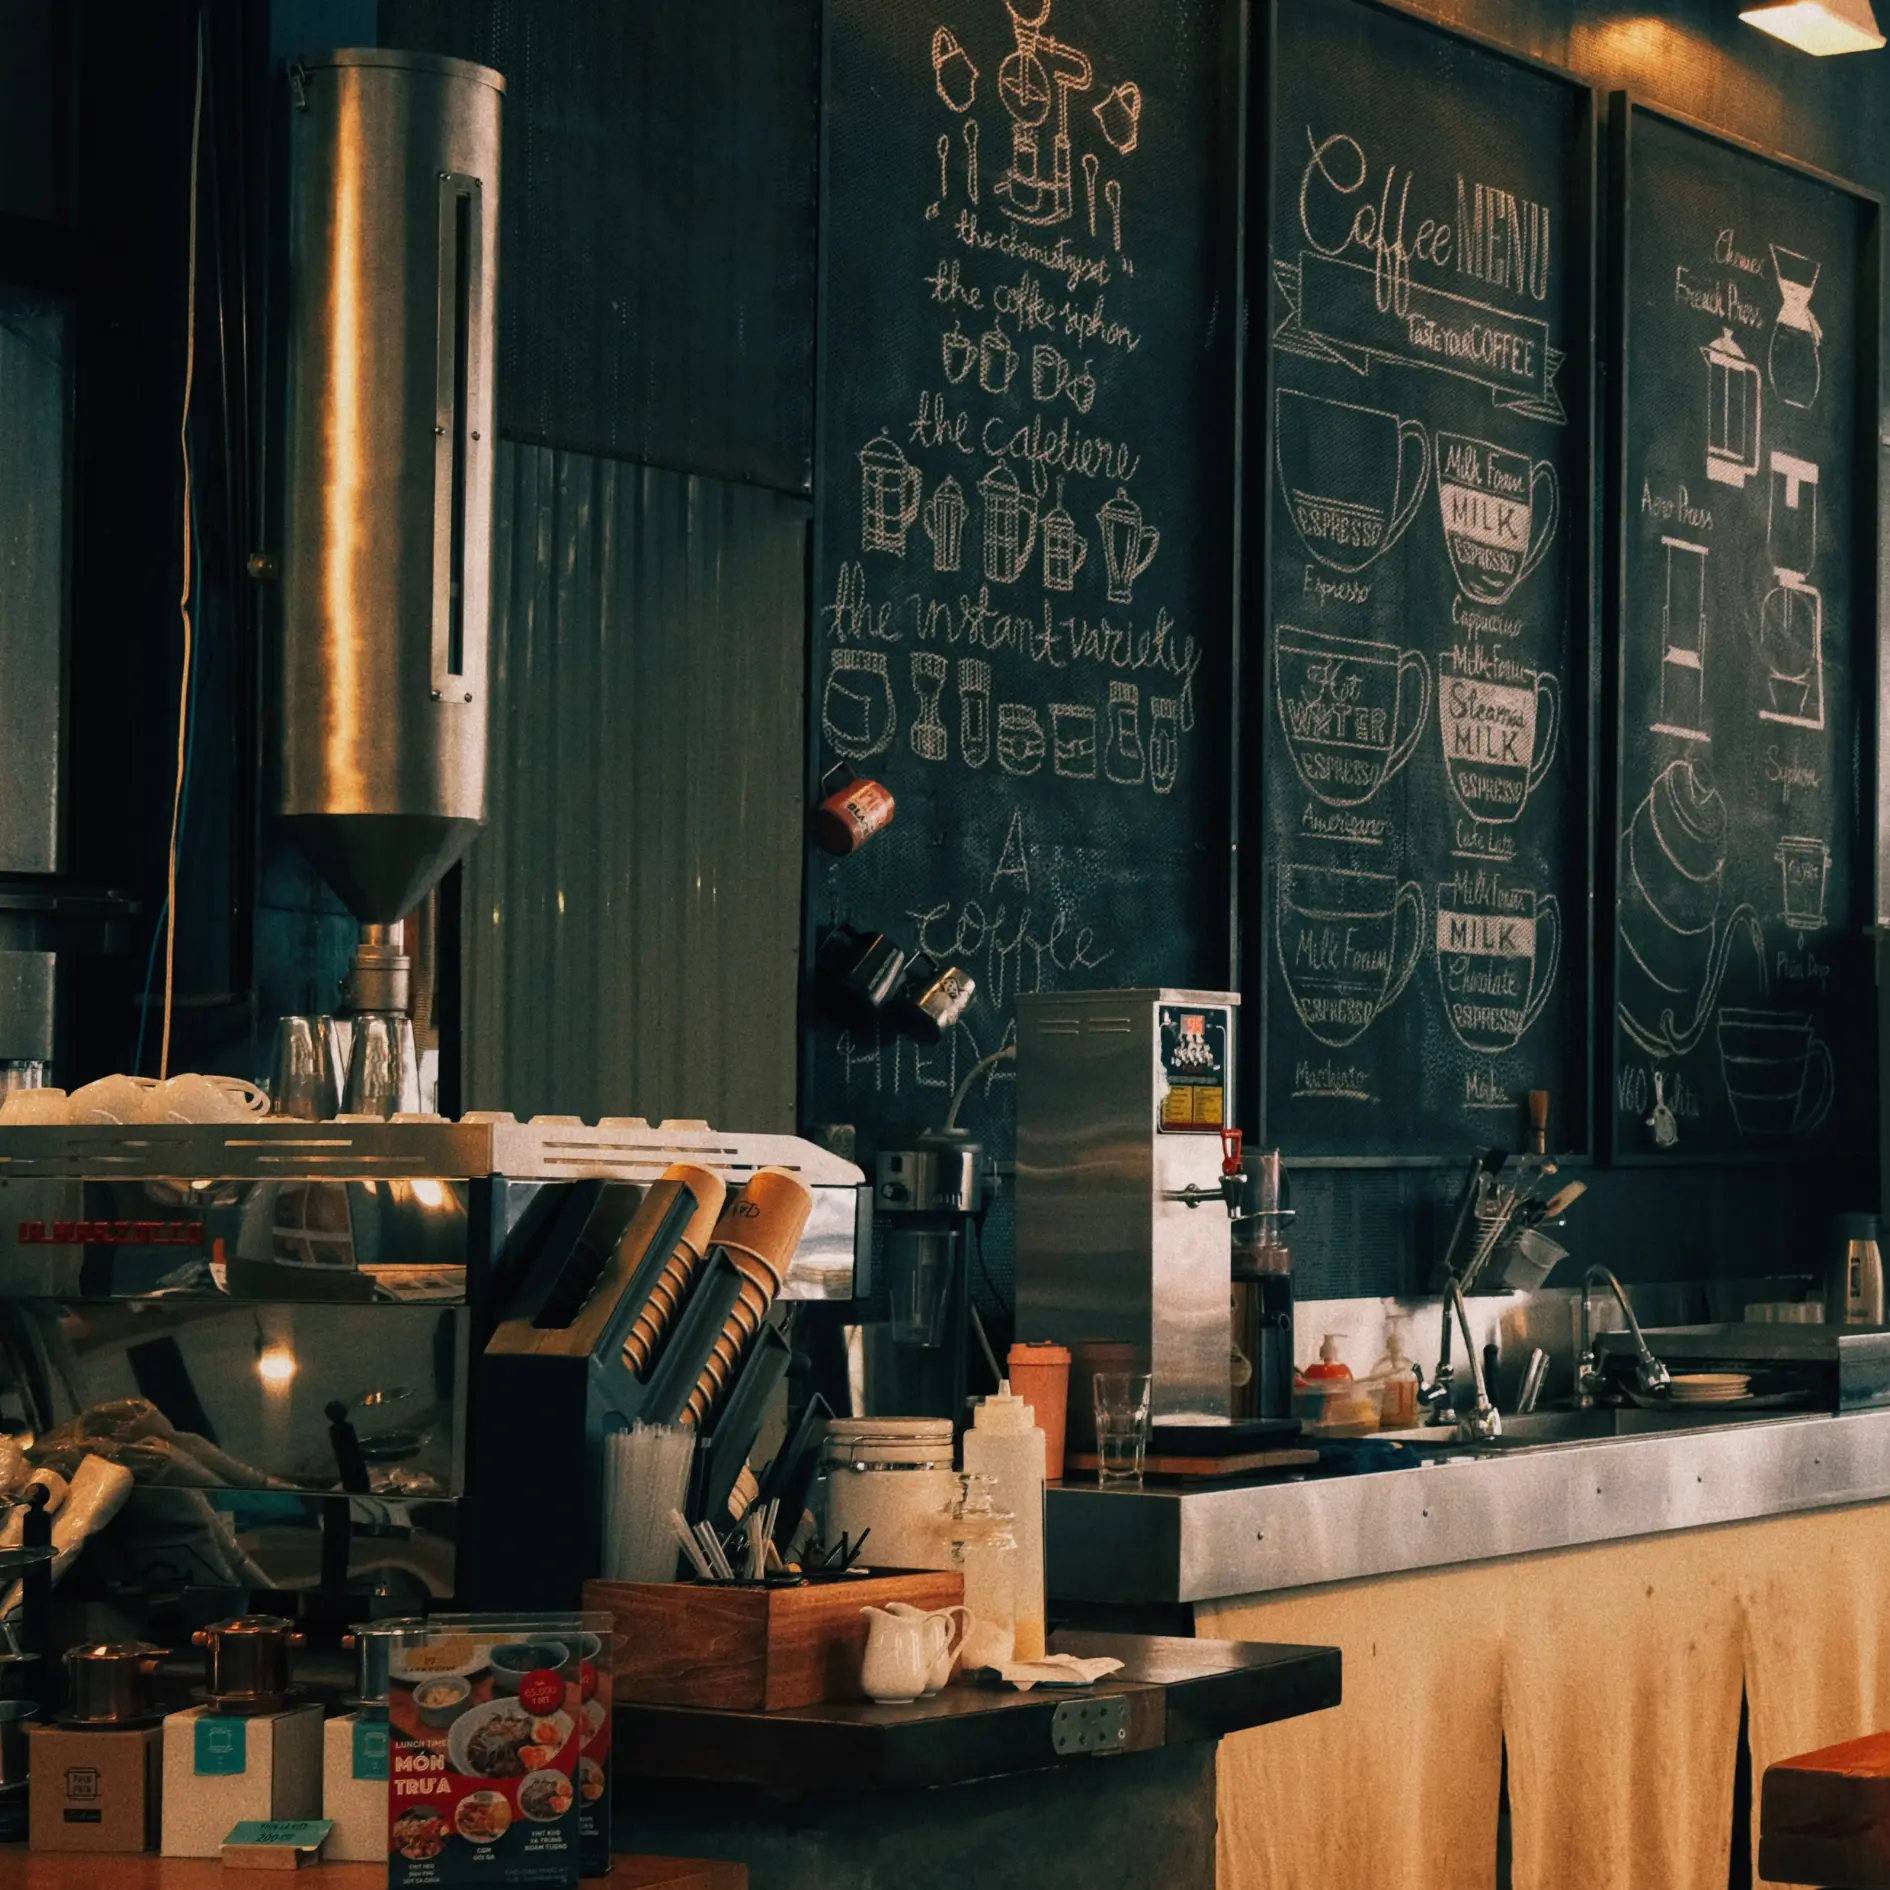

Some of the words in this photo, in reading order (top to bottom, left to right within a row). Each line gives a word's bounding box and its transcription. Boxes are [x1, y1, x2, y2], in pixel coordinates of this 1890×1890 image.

[1300, 124, 1453, 317] Coffee
[1457, 172, 1549, 301] MENU
[1445, 443, 1483, 486] Milk
[1452, 494, 1518, 540] MILK
[1300, 658, 1363, 709] Hot
[1455, 726, 1519, 763] MILK
[1451, 919, 1517, 950] MILK
[395, 1741, 425, 1750] LUNCH
[395, 1751, 445, 1773] MÓN
